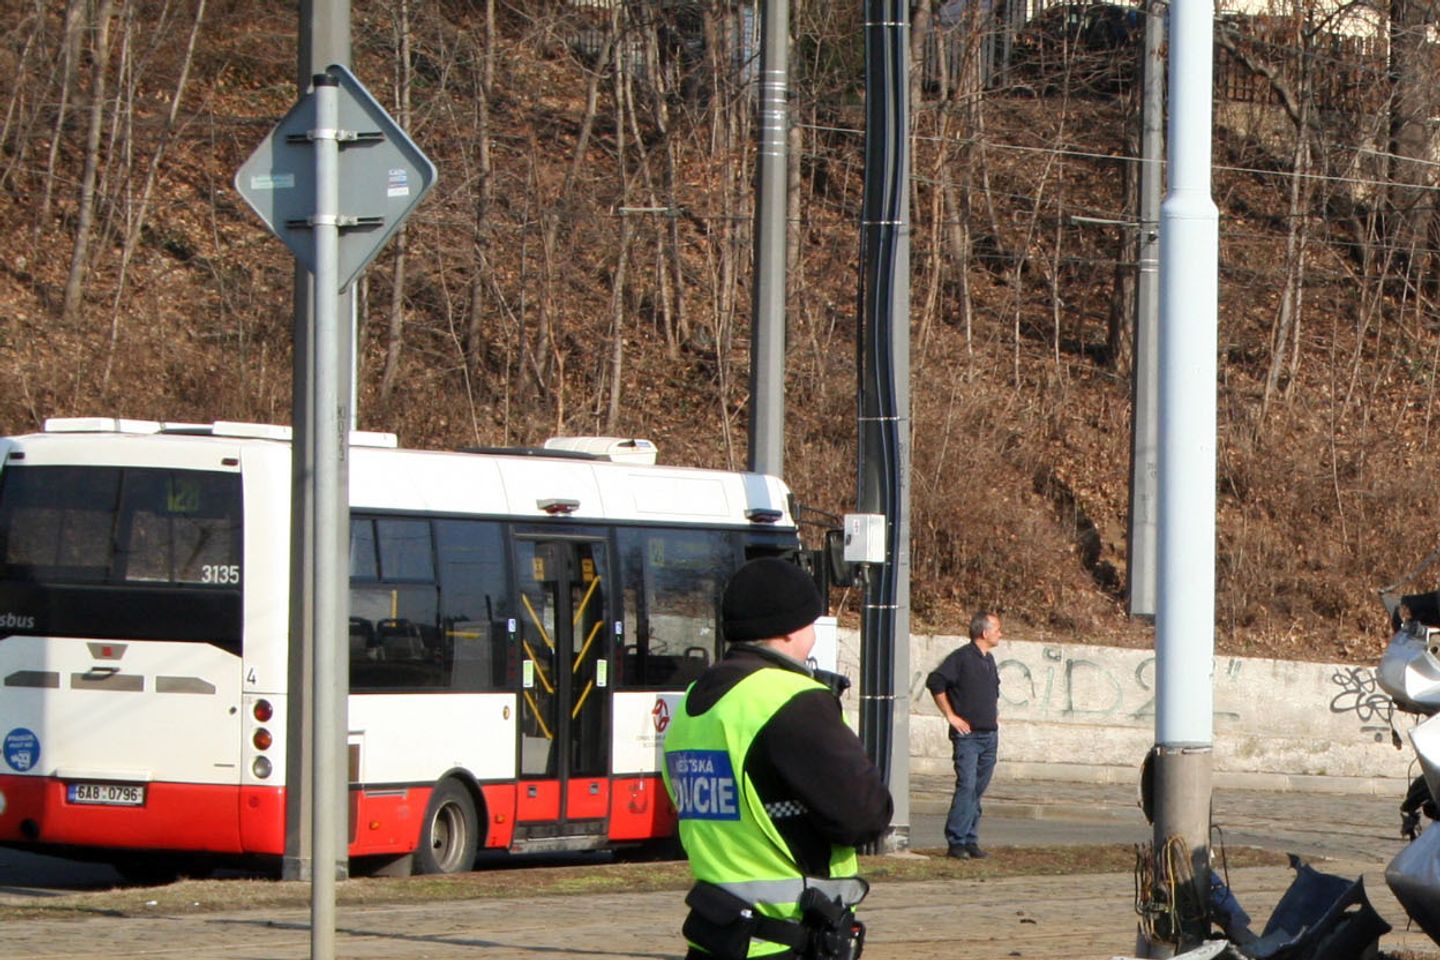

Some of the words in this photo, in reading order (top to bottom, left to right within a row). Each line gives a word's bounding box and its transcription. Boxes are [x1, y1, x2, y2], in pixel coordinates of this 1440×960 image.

[201, 564, 239, 583] 3135
[246, 667, 256, 685] 4
[78, 785, 99, 799] 6A8
[108, 787, 138, 801] 0796
